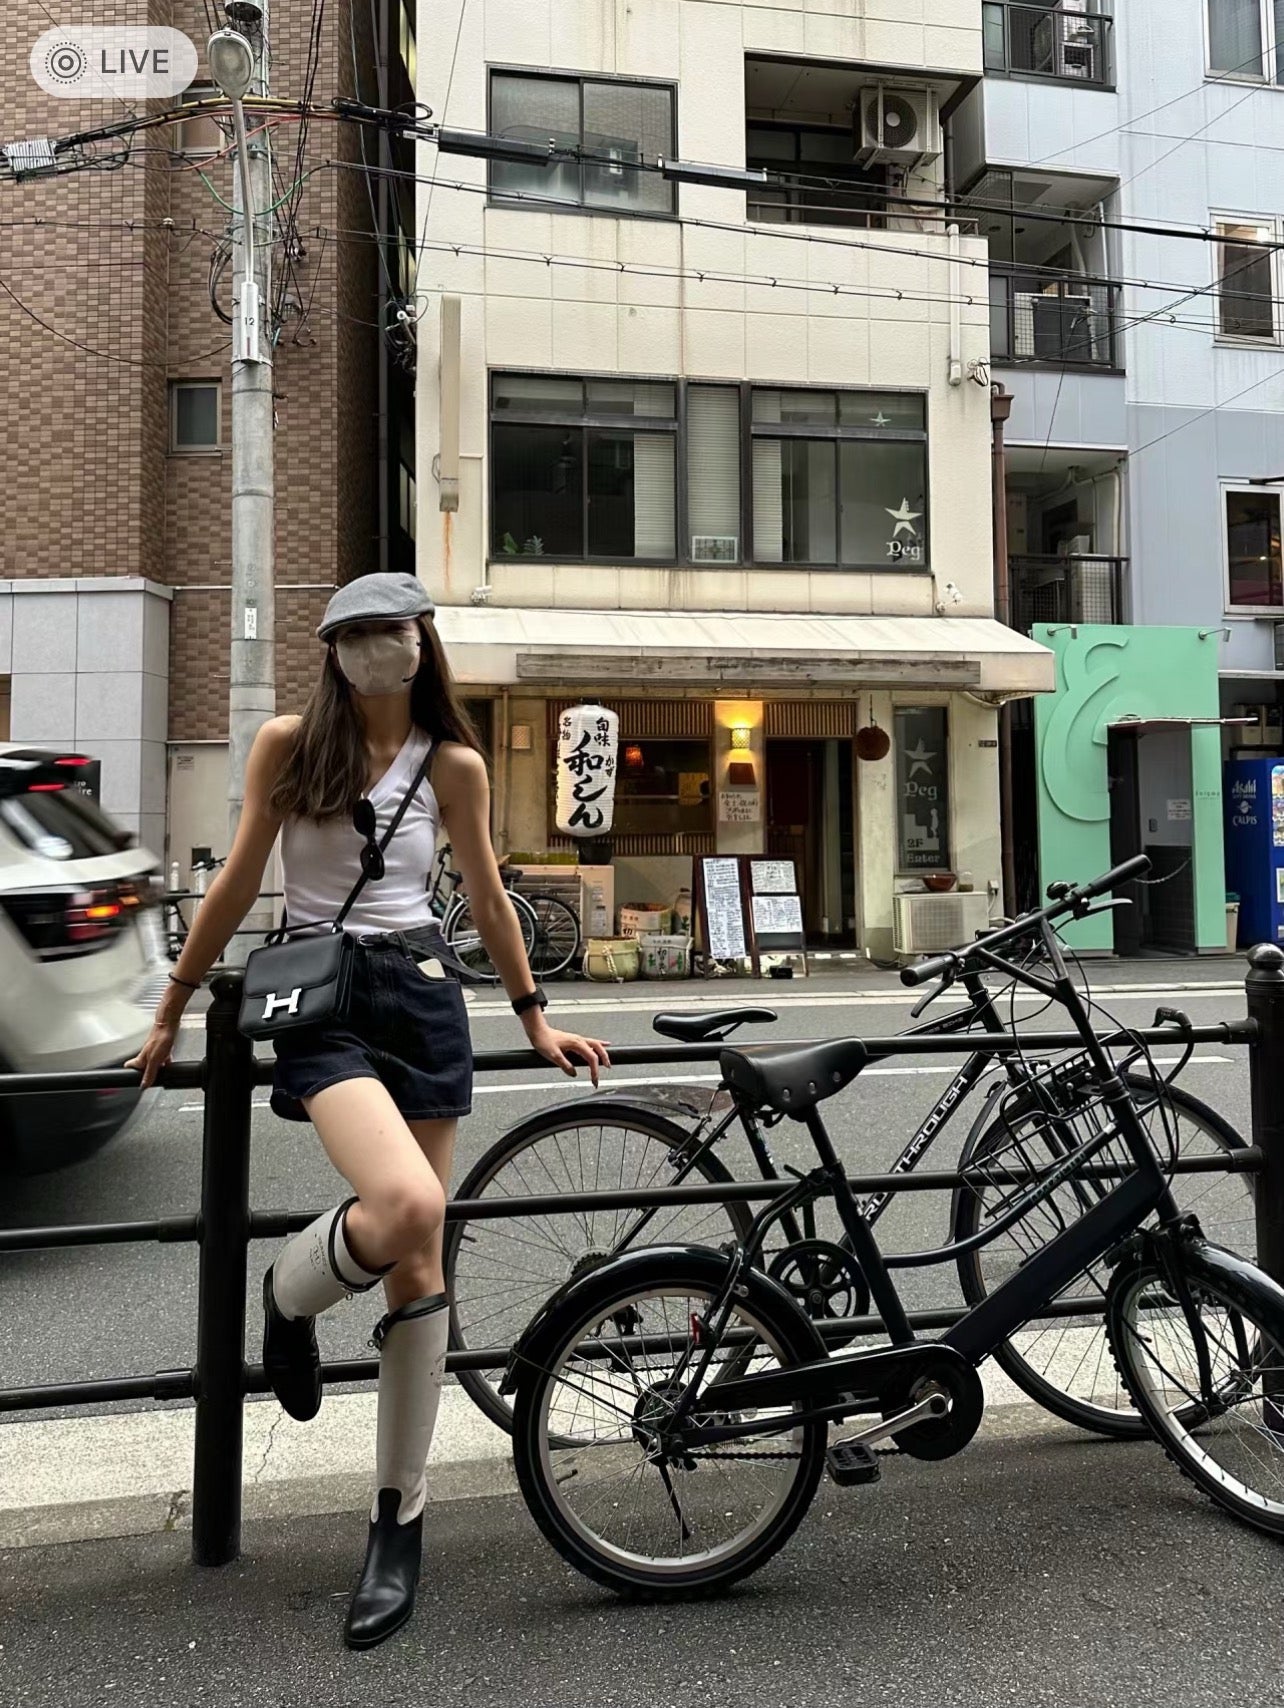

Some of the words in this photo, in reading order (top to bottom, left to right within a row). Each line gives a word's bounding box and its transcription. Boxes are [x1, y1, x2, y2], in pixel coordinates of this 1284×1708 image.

[245, 317, 255, 326] 12
[886, 541, 920, 561] Peg
[594, 716, 611, 747] 旬味
[563, 729, 608, 829] 和しん
[893, 1075, 968, 1174] THROUGH
